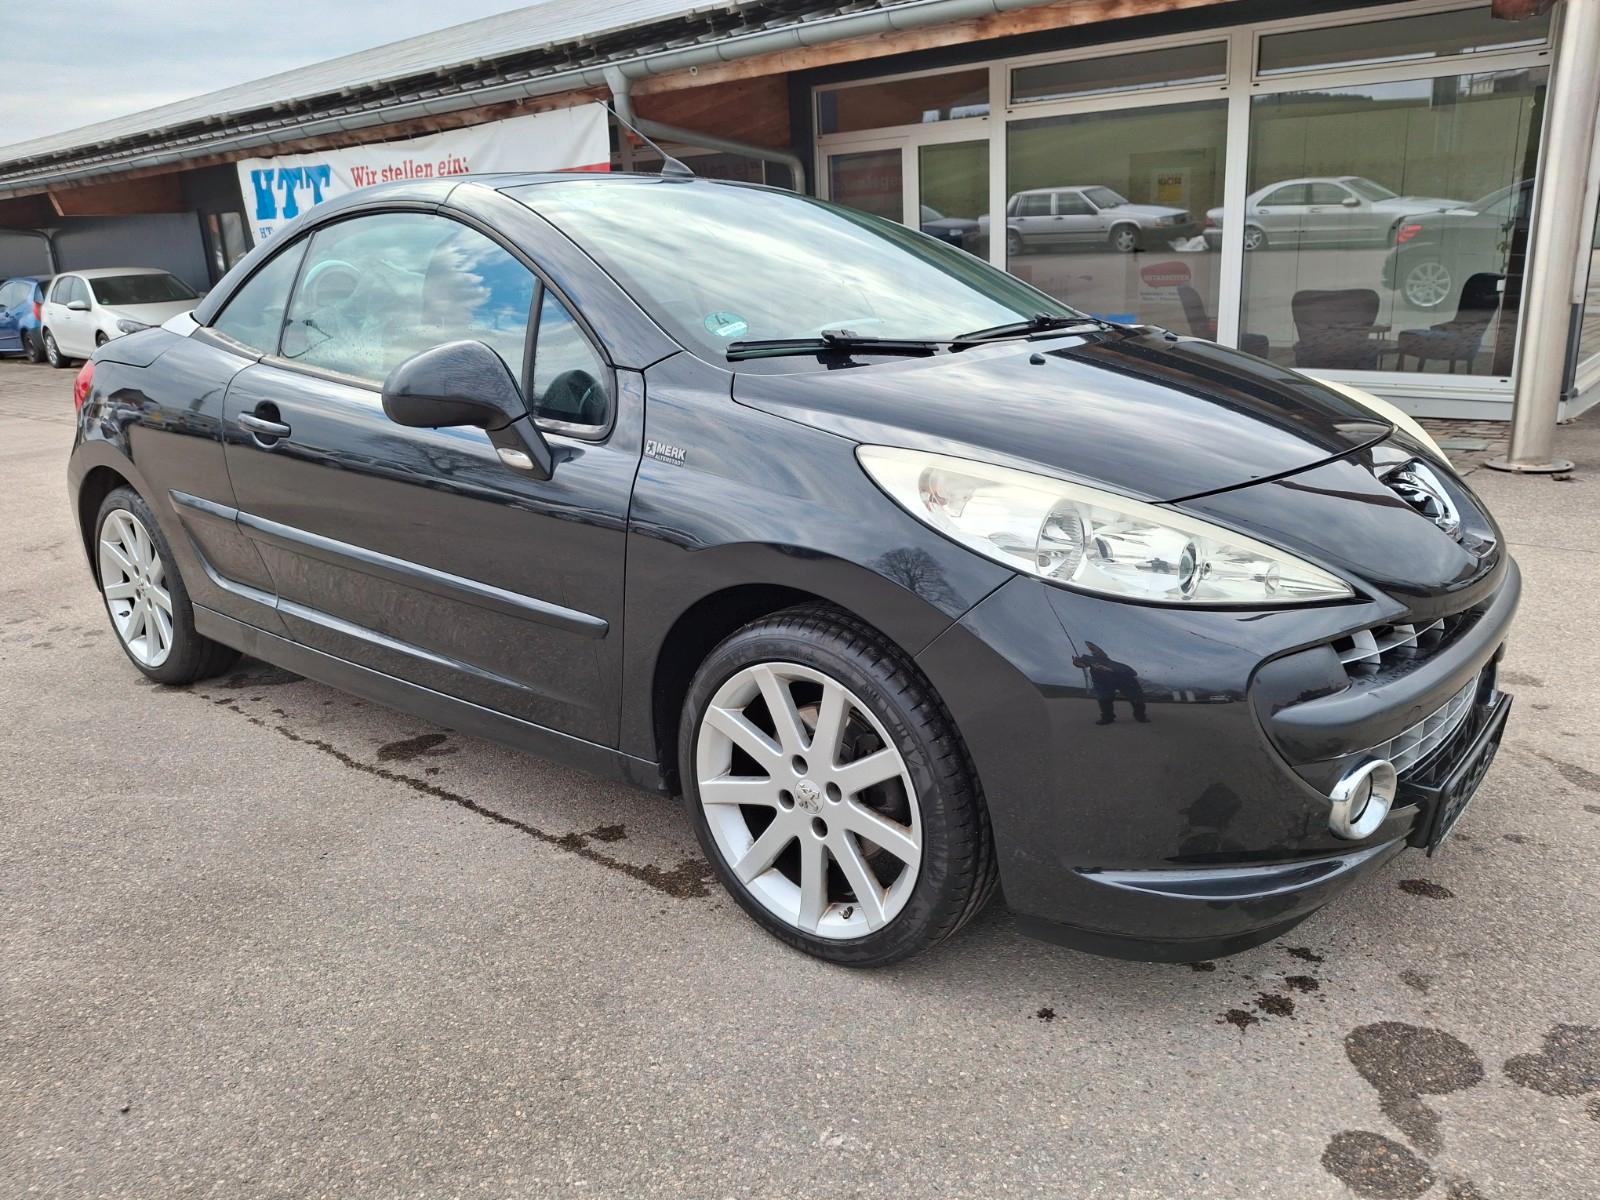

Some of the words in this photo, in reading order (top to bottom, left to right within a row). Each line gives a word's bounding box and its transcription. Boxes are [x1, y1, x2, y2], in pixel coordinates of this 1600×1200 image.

[350, 165, 377, 188] Wir
[381, 159, 433, 182] stellen
[438, 153, 470, 176] ein:
[250, 164, 331, 220] HTT
[656, 442, 686, 461] MERK
